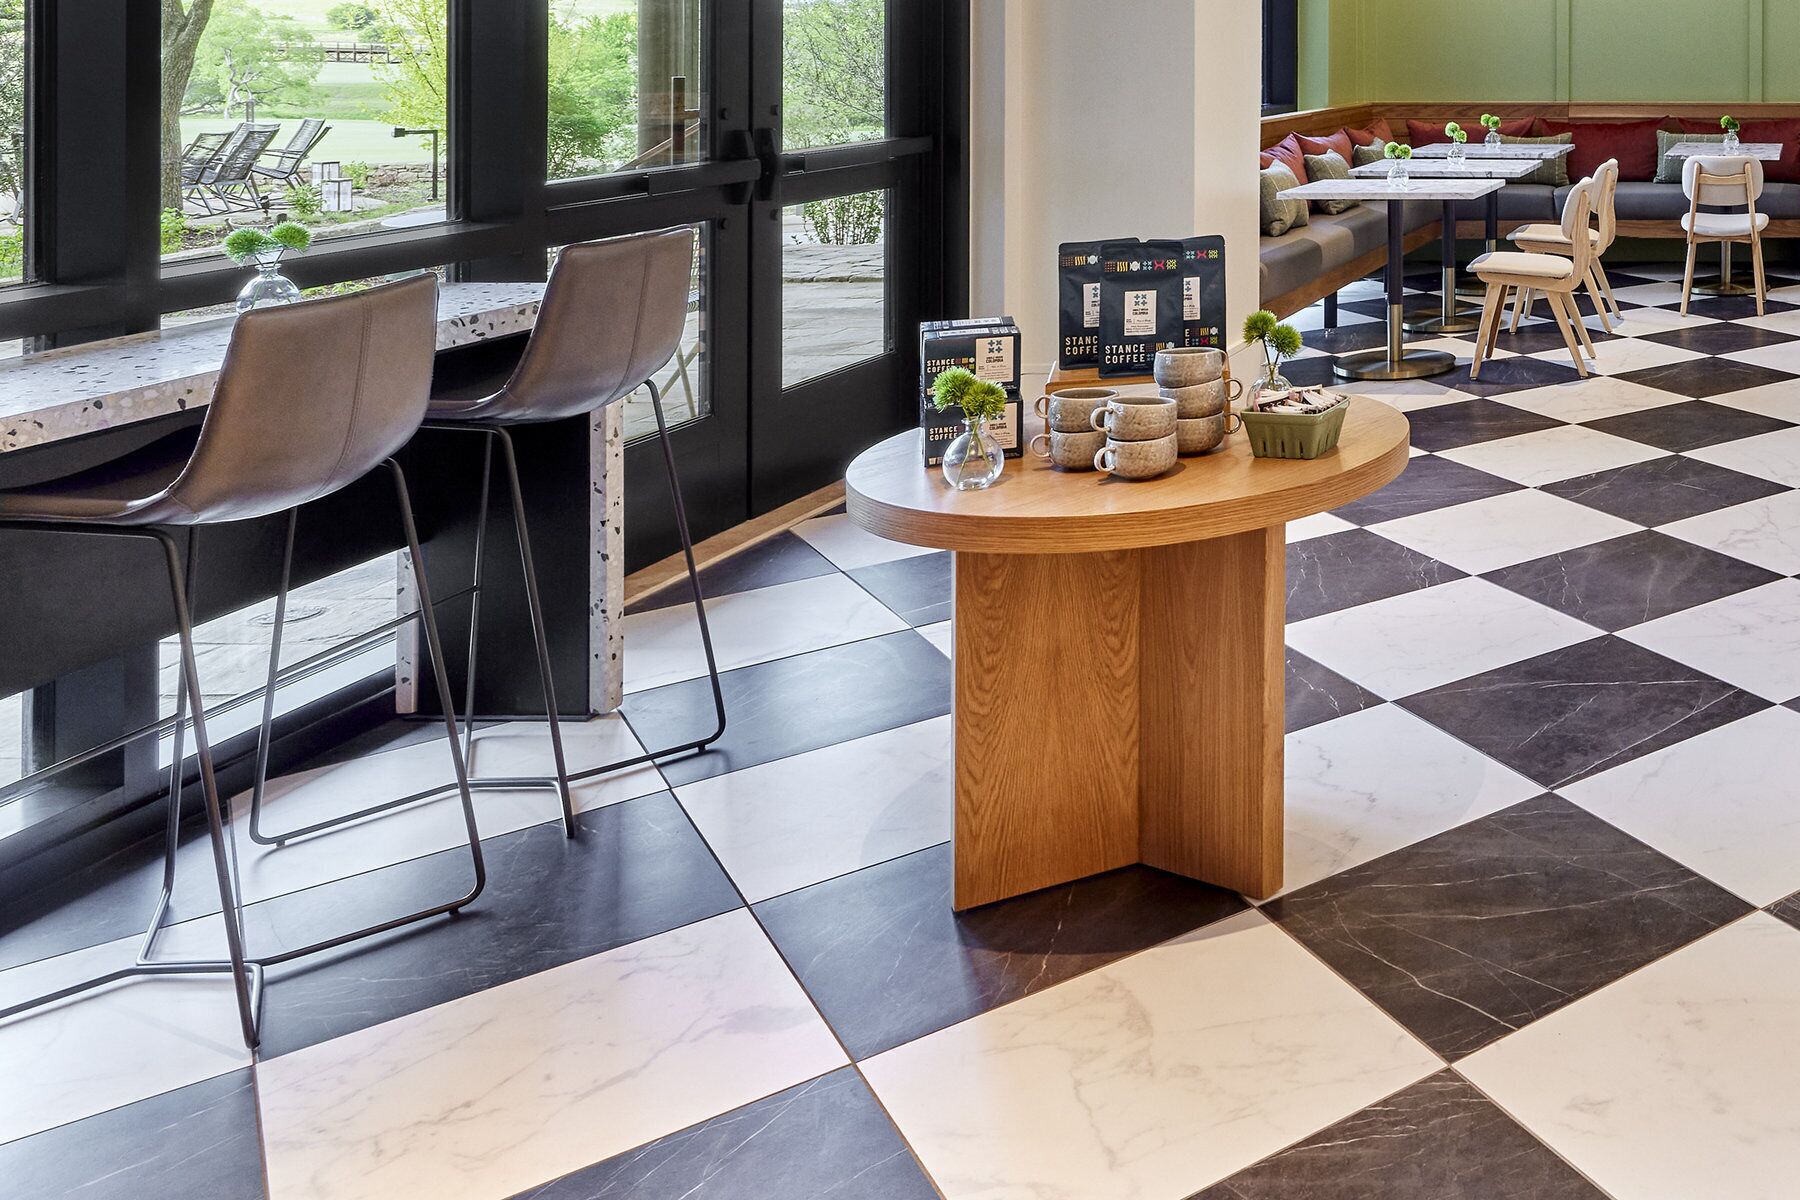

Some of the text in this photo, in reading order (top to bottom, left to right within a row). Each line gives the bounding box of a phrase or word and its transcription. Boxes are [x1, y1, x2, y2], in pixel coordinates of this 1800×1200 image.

[1065, 335, 1098, 346] STANC
[1065, 345, 1098, 355] COFFE
[1105, 343, 1145, 354] STANCE
[927, 358, 955, 367] STANCE
[1105, 354, 1145, 364] COFFEE
[929, 425, 957, 435] STANCE
[929, 433, 957, 442] COFFEE
